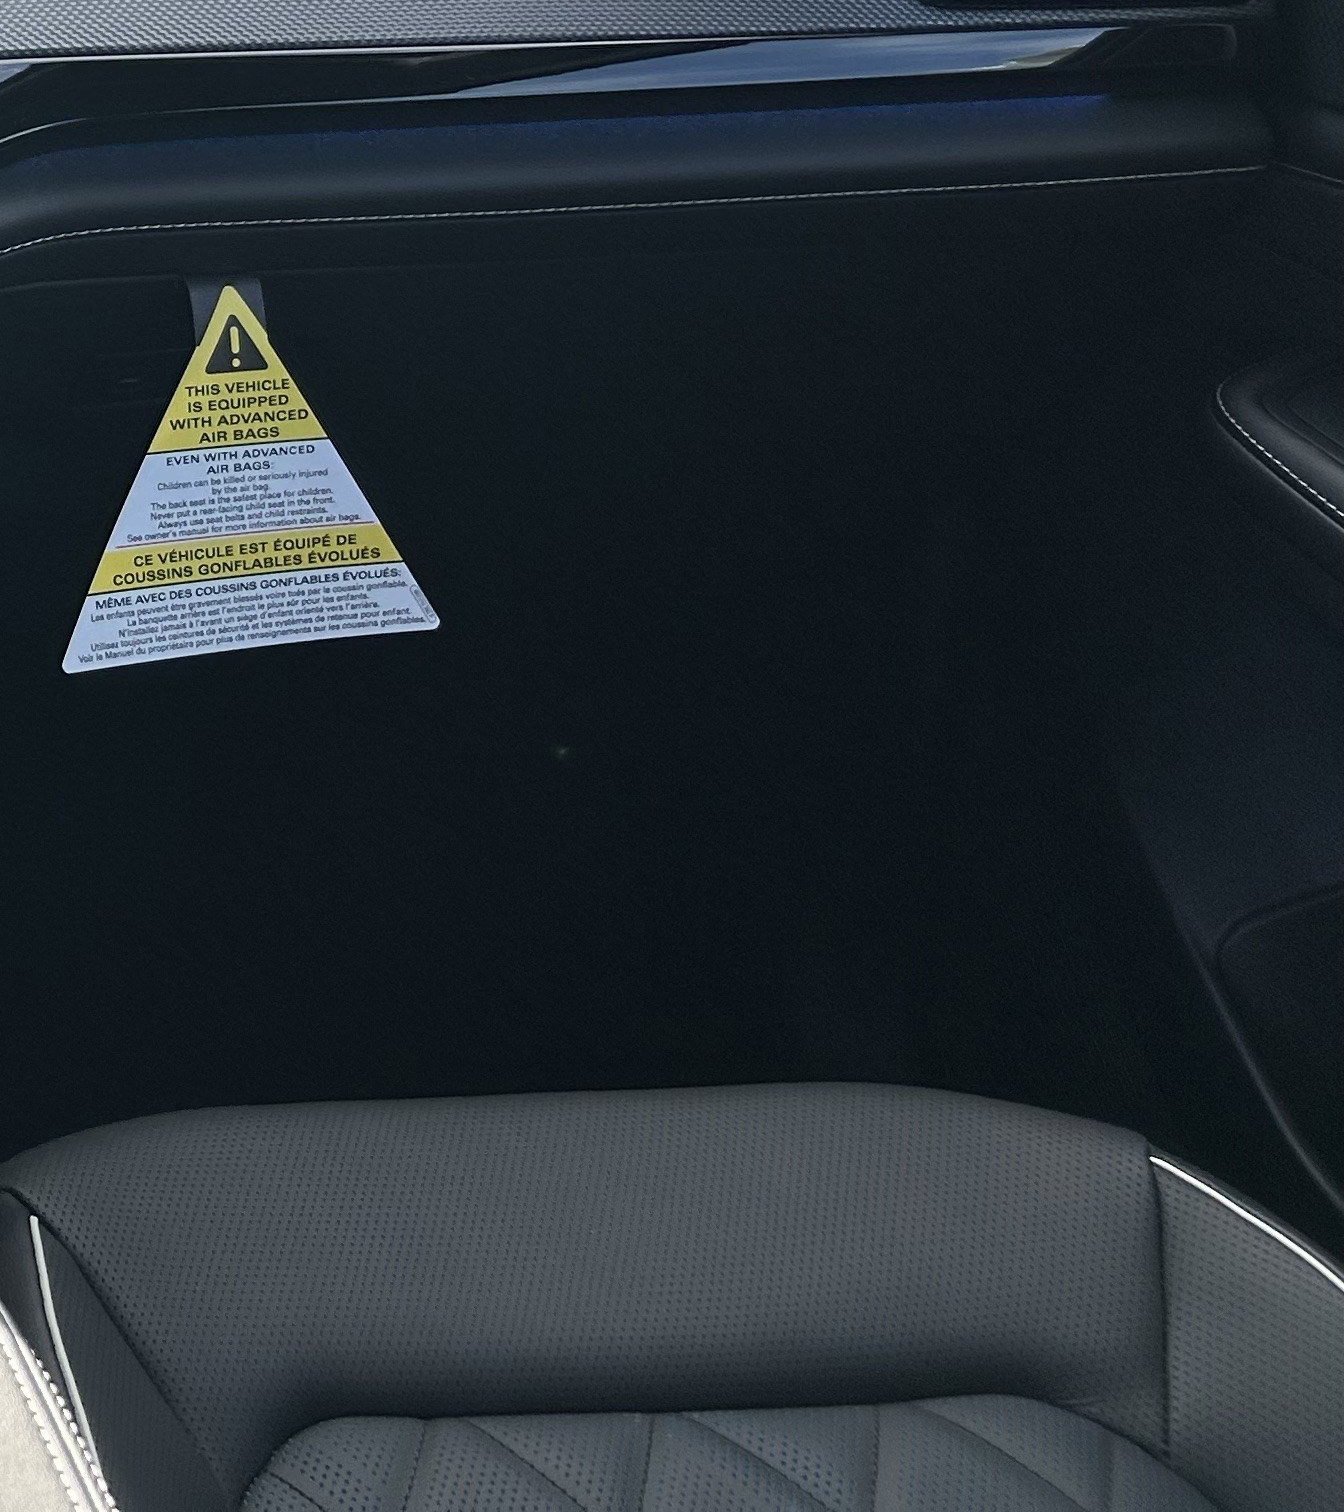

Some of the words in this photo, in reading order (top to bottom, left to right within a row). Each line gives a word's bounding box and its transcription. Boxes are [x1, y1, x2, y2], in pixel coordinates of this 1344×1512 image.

[184, 383, 221, 397] THIS
[224, 378, 290, 394] VEHICLE
[187, 400, 203, 413] IS
[207, 394, 289, 411] EQUIPPED
[169, 416, 212, 431] WITH
[216, 408, 309, 426] ADVANCED
[198, 430, 228, 444] AIR
[233, 426, 280, 441] BAGS
[166, 453, 200, 466] EVEN
[203, 450, 238, 462] WITH
[241, 444, 315, 459] ADVANCED
[206, 464, 229, 475] AIR
[133, 554, 153, 567] CE
[156, 545, 234, 564] VÉHICULE
[239, 541, 268, 555] EST
[273, 535, 331, 552] ÉQUIPÉ
[336, 533, 357, 546] DE
[112, 565, 193, 586] COUSSINS
[197, 553, 303, 576] GONFLABLES
[307, 546, 381, 564] ÉVOLUÉS
[95, 595, 132, 610] MÊME
[134, 592, 166, 605] AVEC
[168, 589, 192, 600] DES
[195, 582, 257, 597] COUSSINS
[259, 574, 339, 589] GONFLABLES
